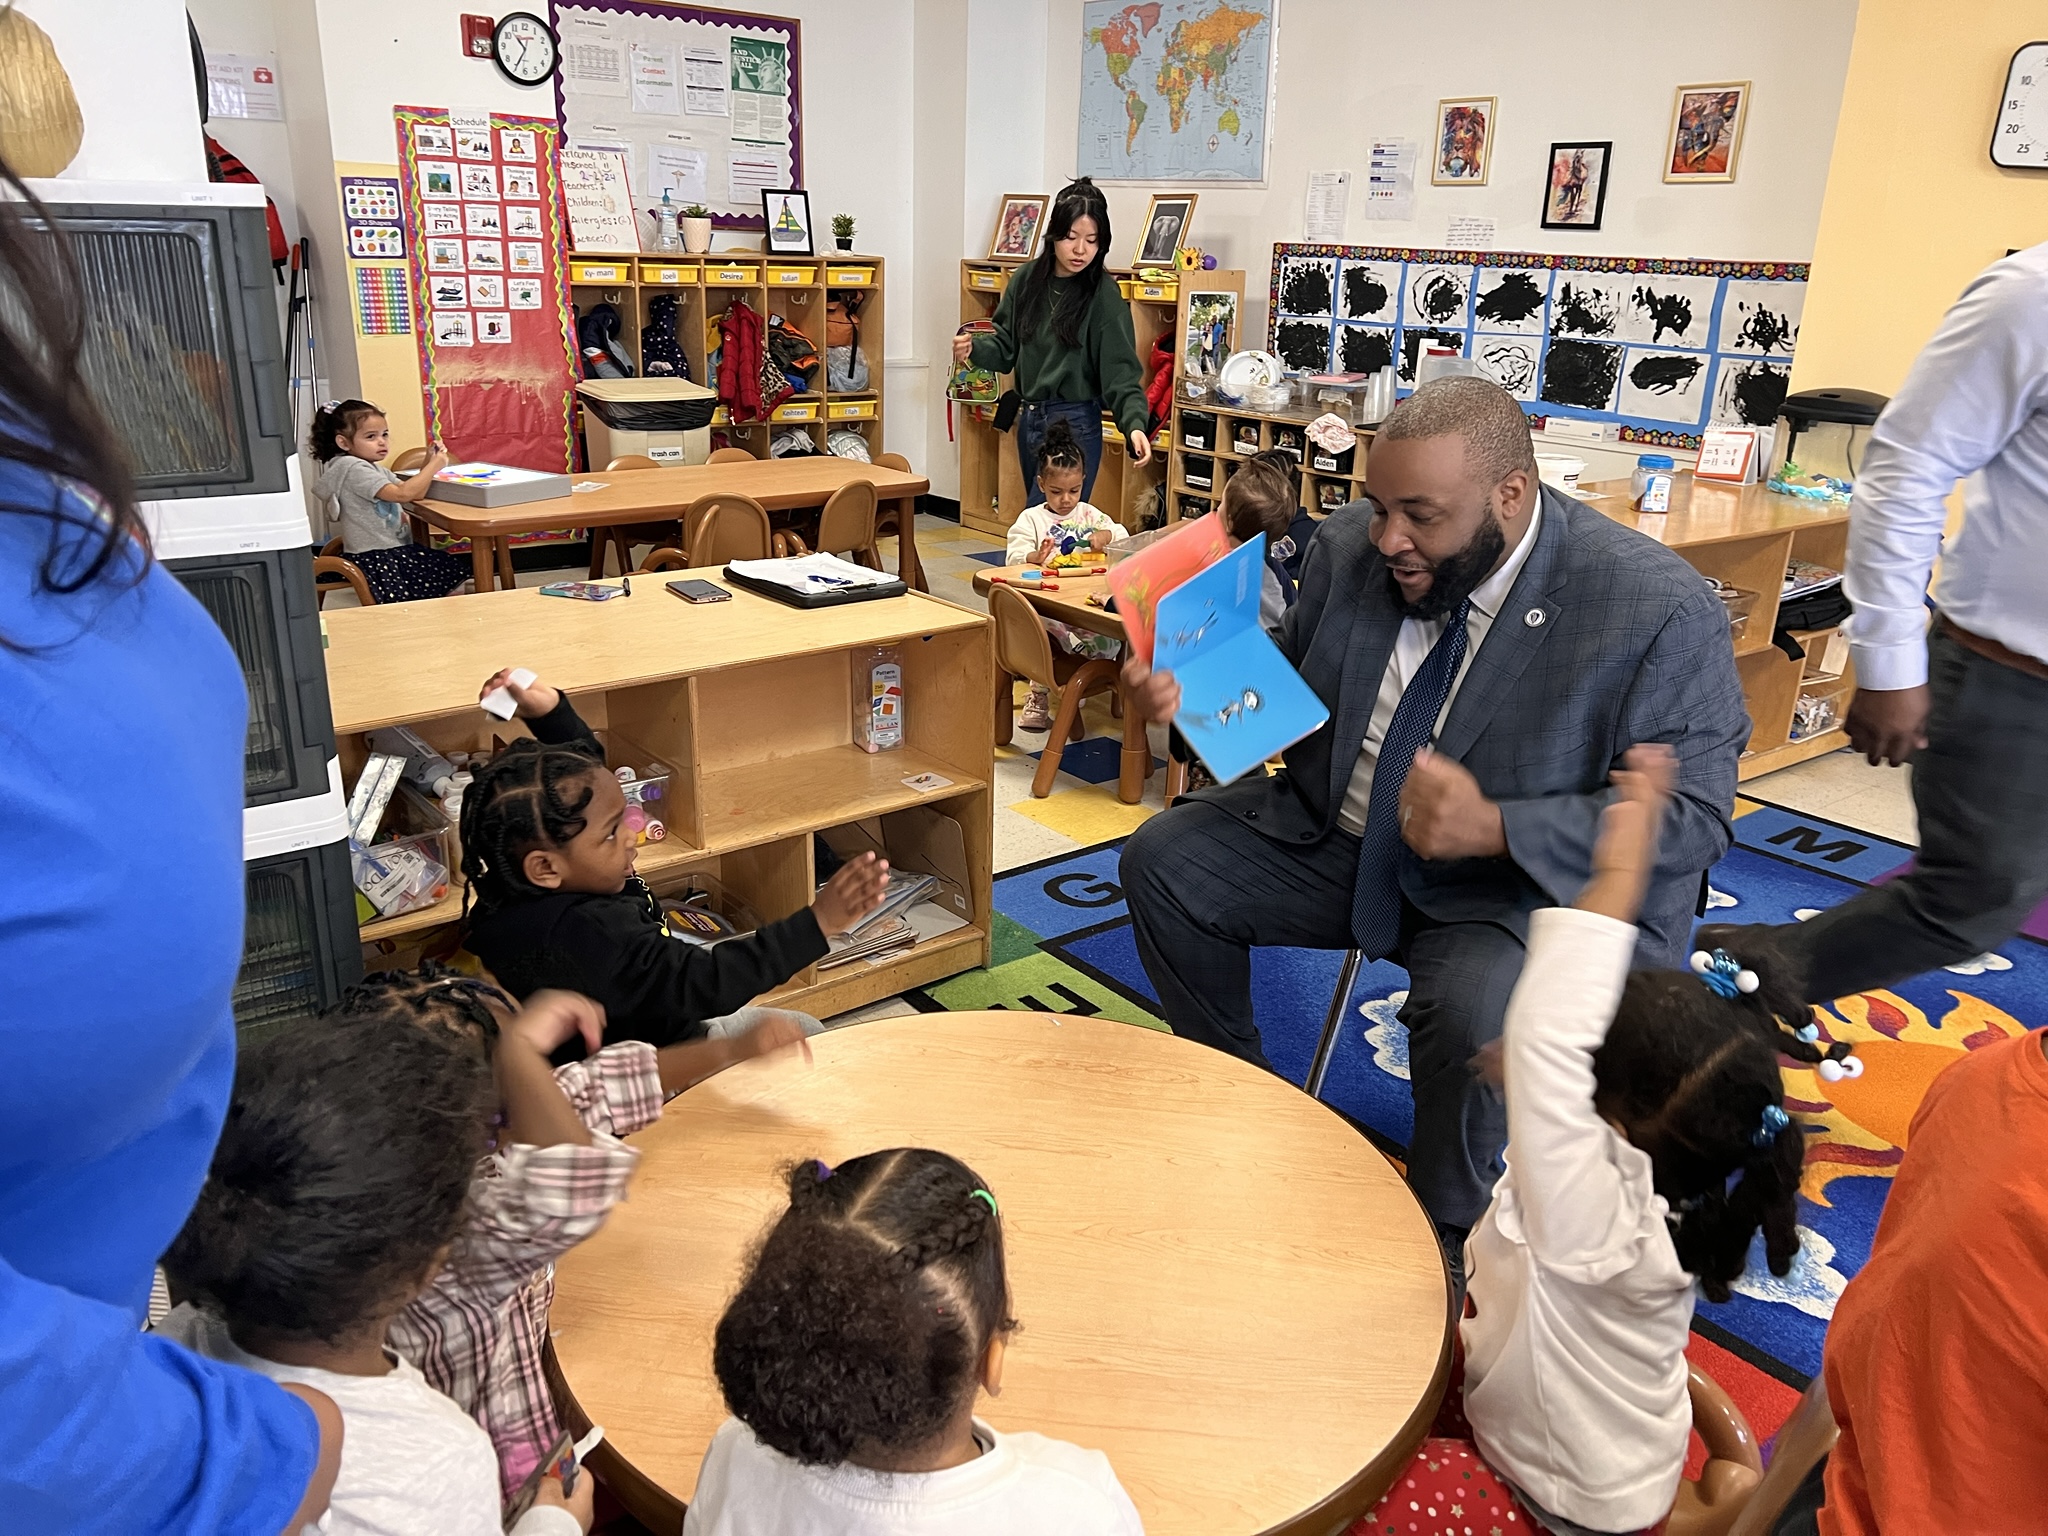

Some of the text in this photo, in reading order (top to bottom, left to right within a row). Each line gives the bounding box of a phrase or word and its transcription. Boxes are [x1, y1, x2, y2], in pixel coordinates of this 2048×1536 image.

[512, 24, 517, 32] 11
[2021, 76, 2032, 85] 10
[2008, 100, 2018, 110] 15
[452, 118, 487, 126] Schedule
[2006, 124, 2019, 133] 20
[2017, 144, 2030, 153] 25
[1765, 826, 1869, 862] M
[1043, 873, 1126, 908] G
